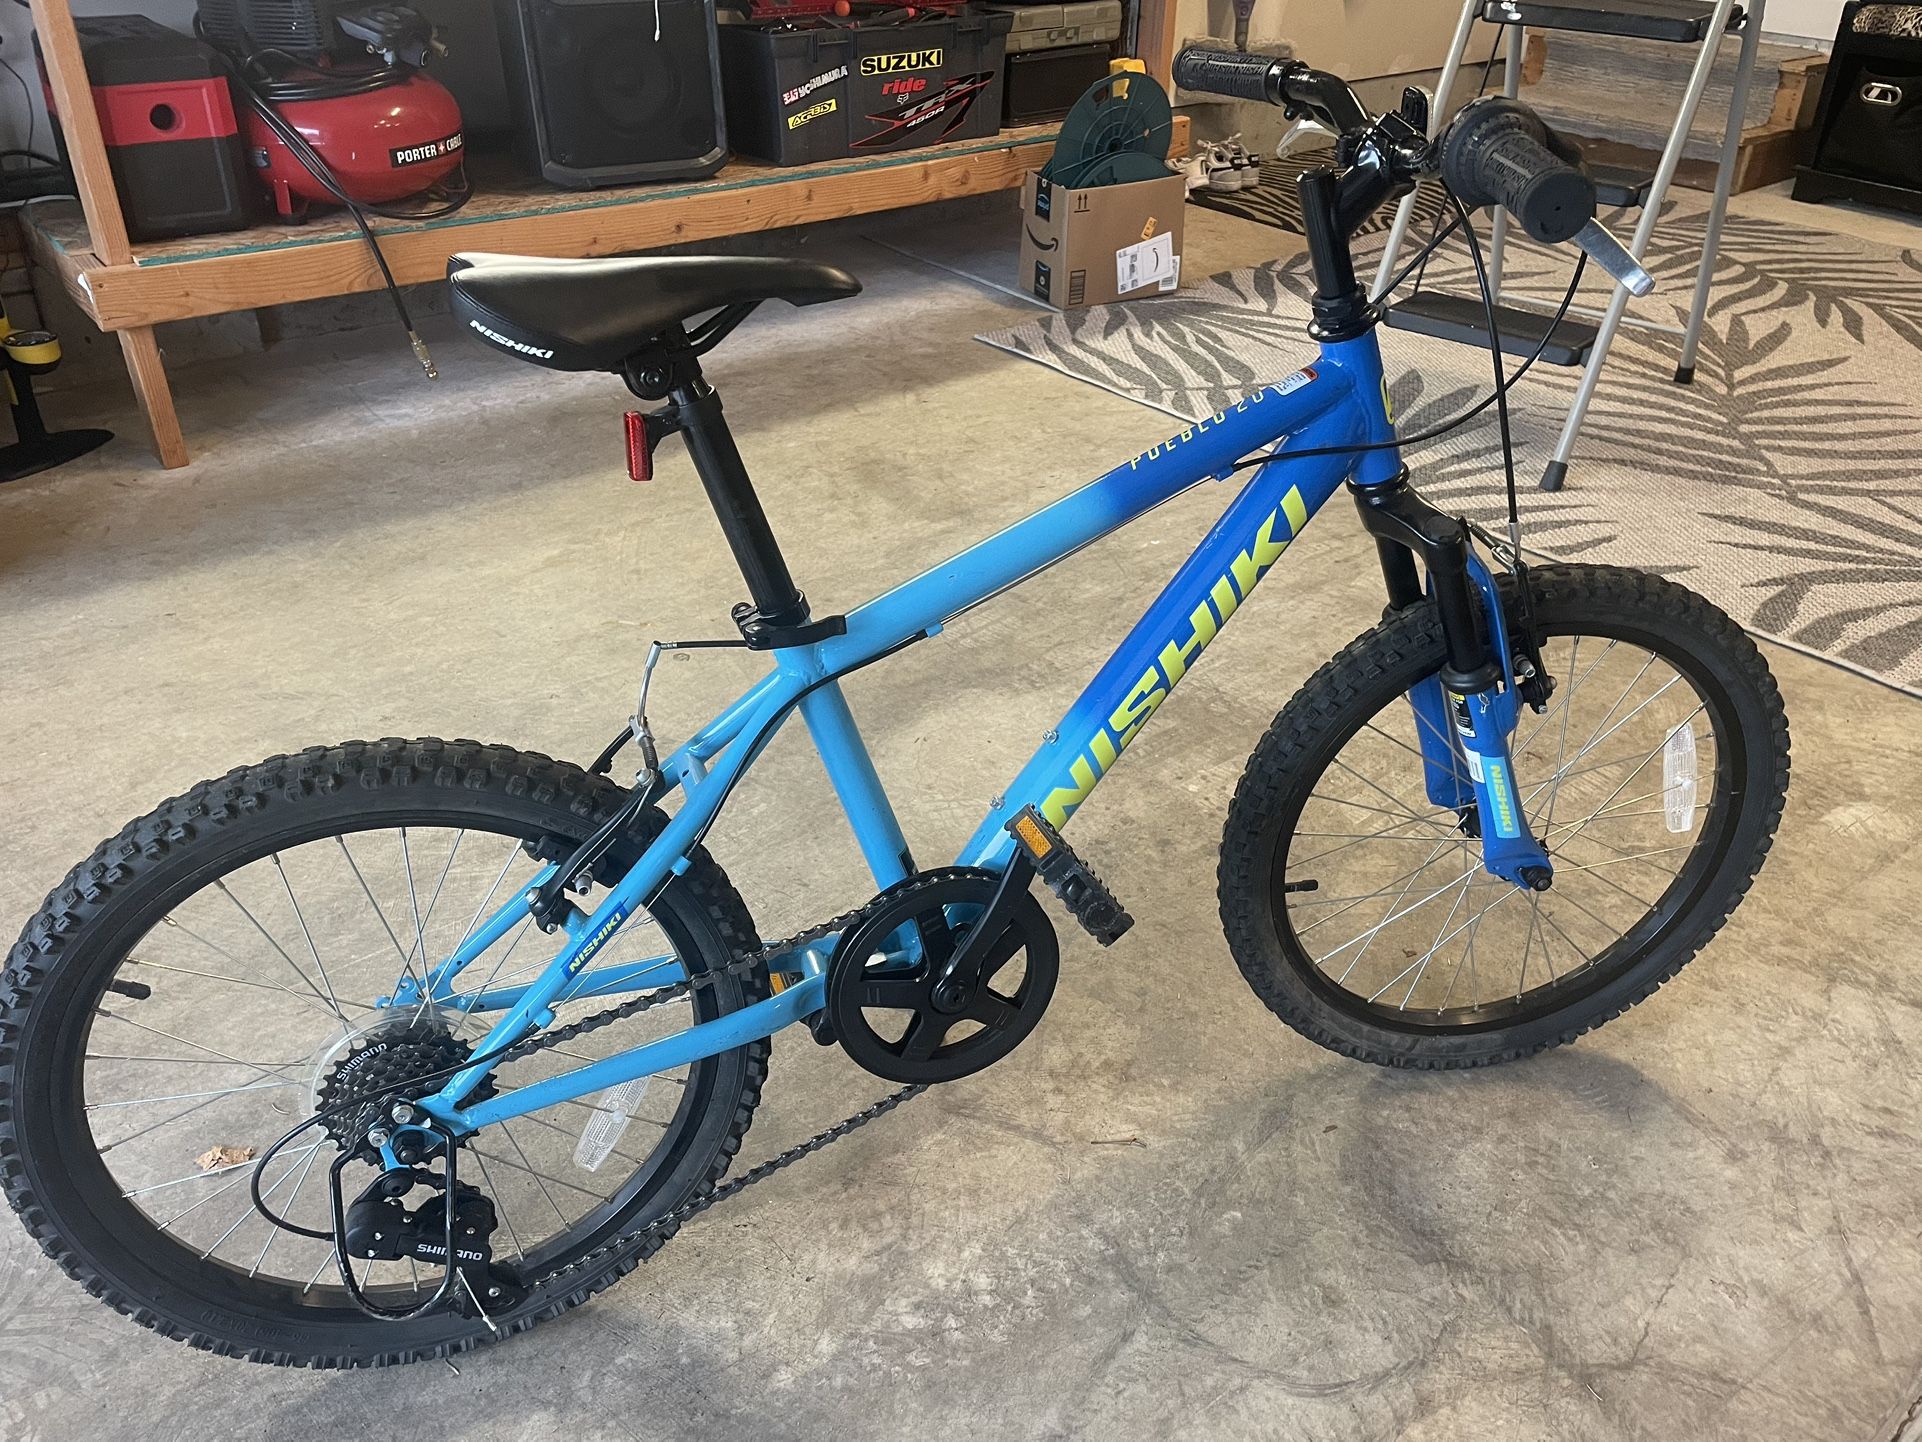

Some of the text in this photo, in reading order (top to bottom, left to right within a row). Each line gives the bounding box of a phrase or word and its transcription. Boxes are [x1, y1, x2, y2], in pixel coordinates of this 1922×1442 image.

[861, 50, 942, 75] SUZUKI
[881, 76, 927, 95] ride
[906, 106, 945, 127] 450R
[396, 144, 437, 164] PORTER
[469, 319, 554, 359] NISHIKI
[1040, 484, 1308, 832] NISHIKI
[1489, 764, 1513, 833] NISHIKI
[568, 912, 622, 973] NISHIKI
[336, 1042, 388, 1081] SHIMANO
